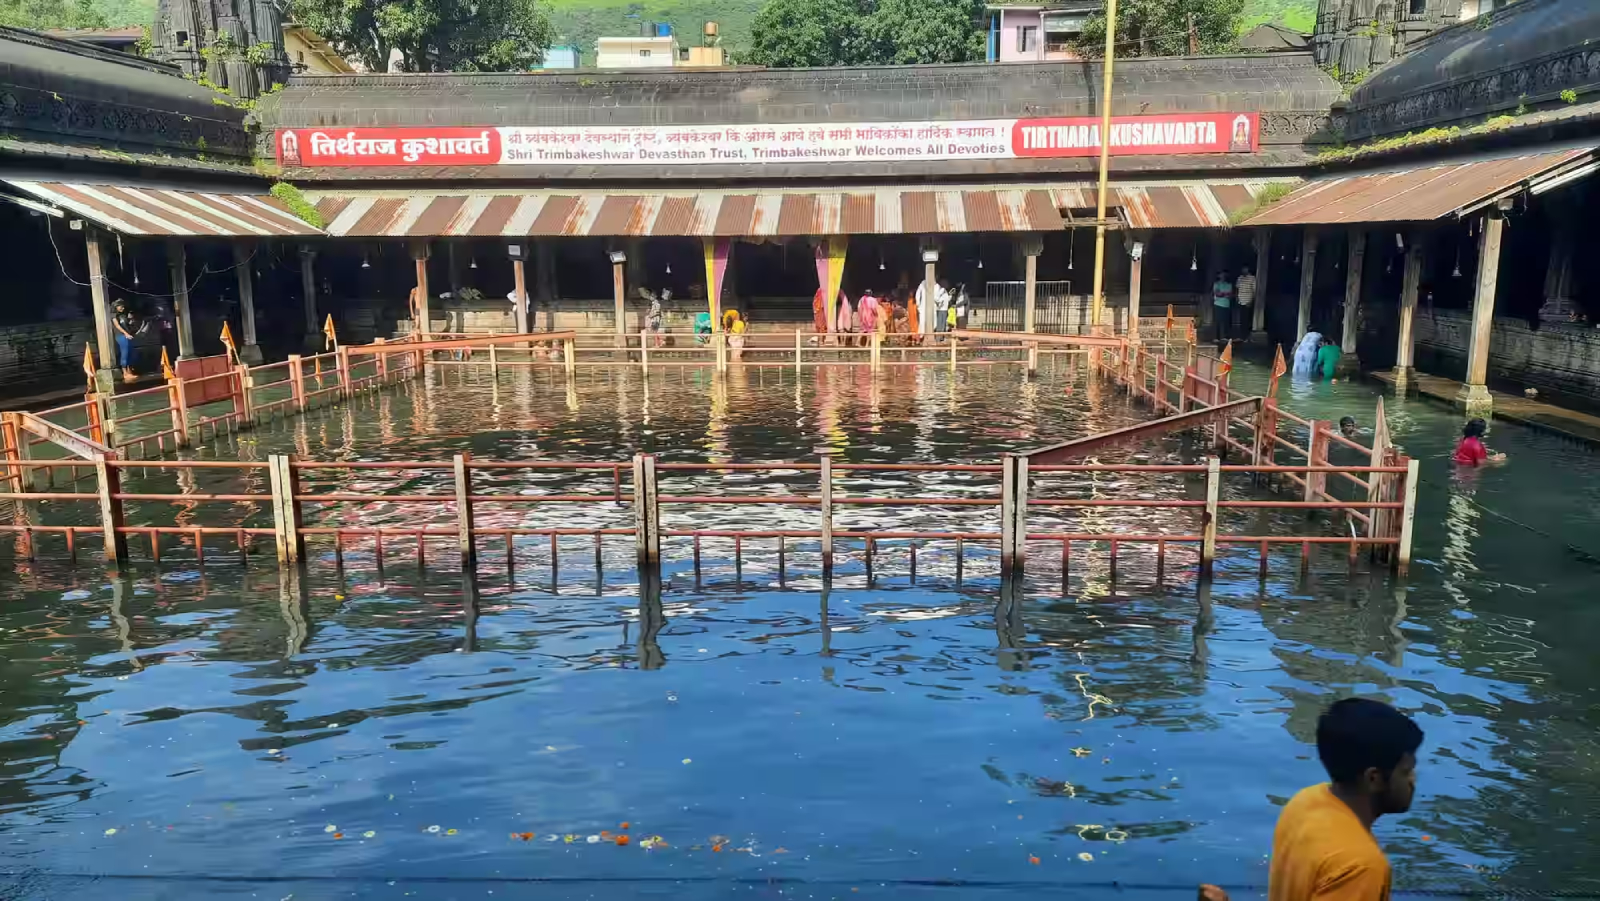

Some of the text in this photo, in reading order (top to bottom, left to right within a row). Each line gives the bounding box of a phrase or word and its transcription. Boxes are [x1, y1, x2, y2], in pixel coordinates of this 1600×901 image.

[507, 130, 521, 144] श्री
[828, 127, 852, 141] सभी
[956, 127, 995, 138] स्वागत
[1021, 121, 1217, 149] TIRTHARA KUSHAVARTA
[310, 131, 490, 162] तिर्थराज कुशावर्त
[507, 143, 1006, 160] Shri Trimbakeshwar Devasthan Trust, Trimbakeshwar Welcomes All Devoties
